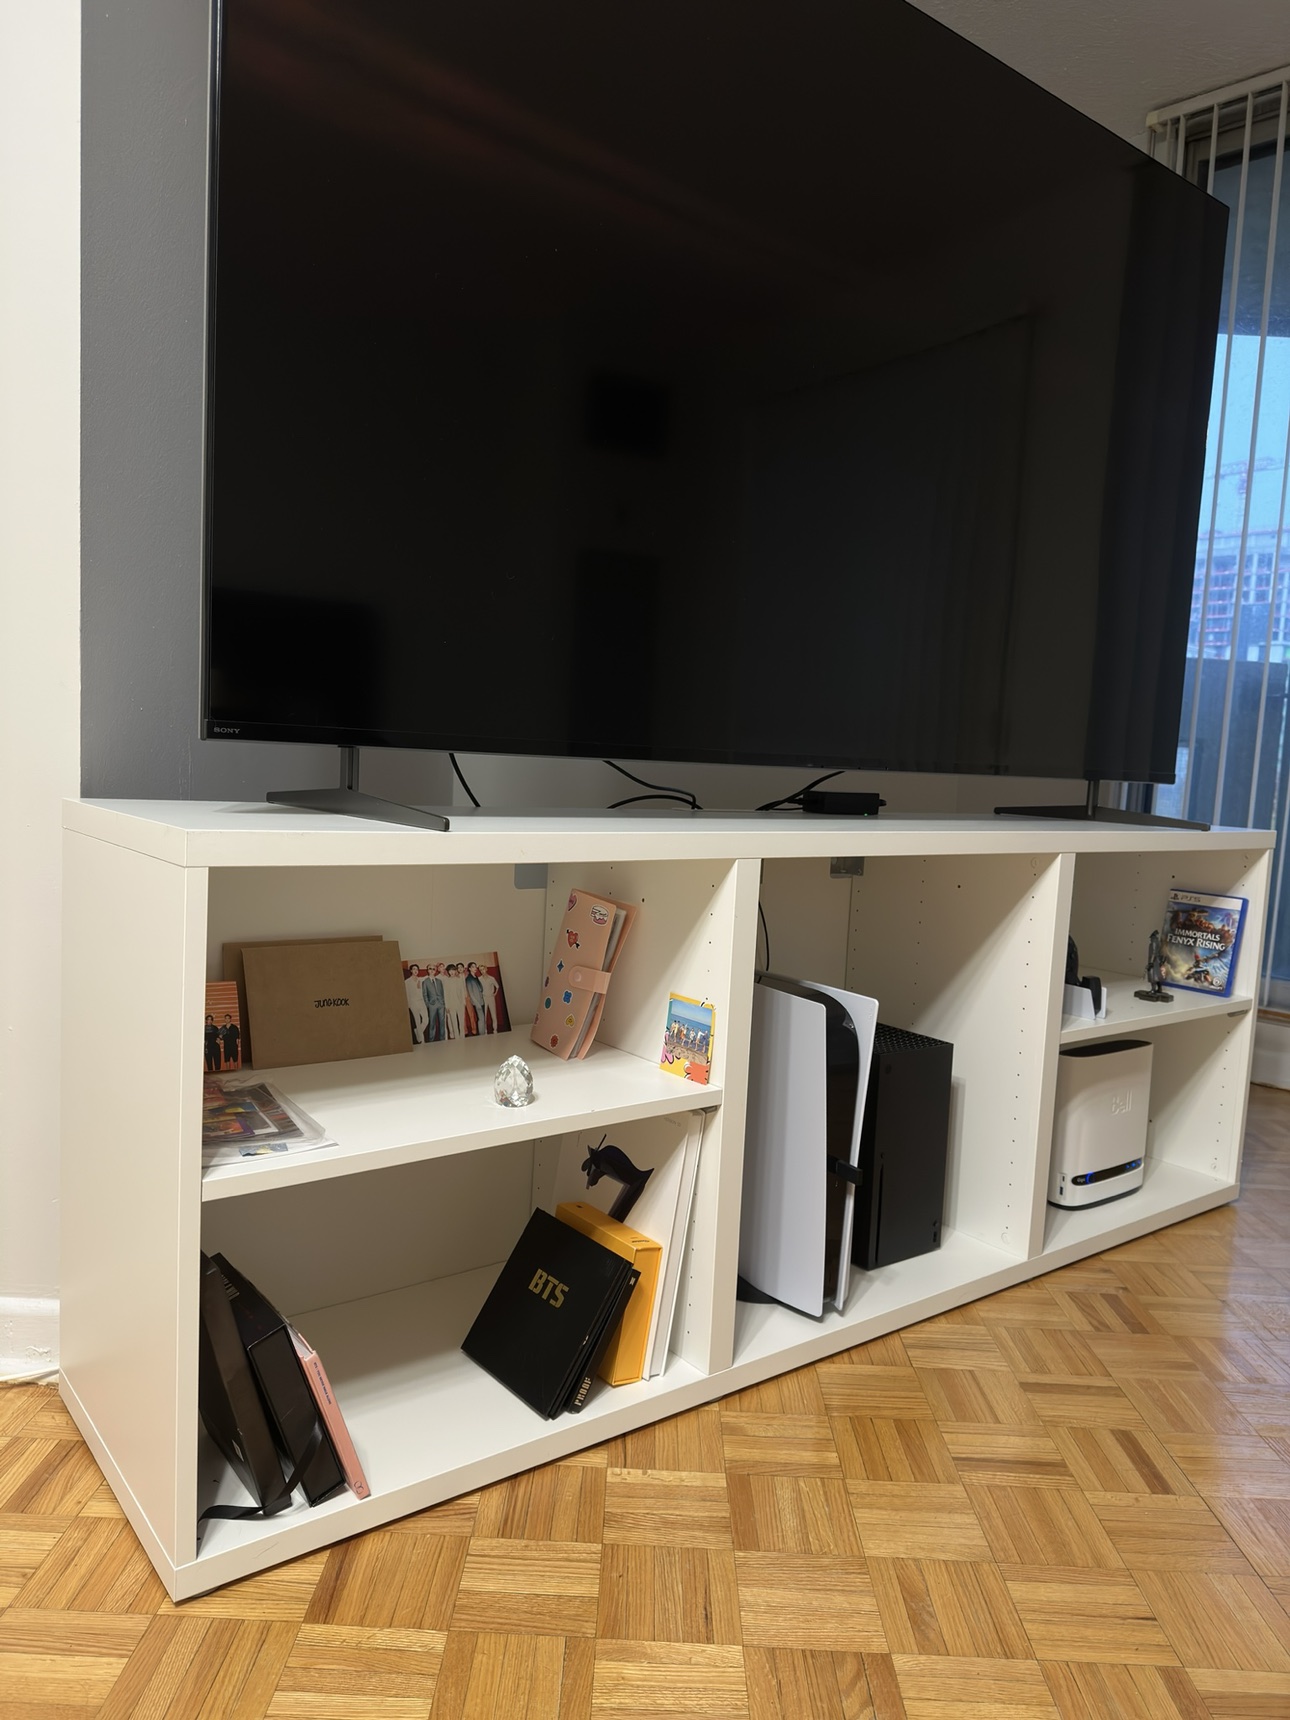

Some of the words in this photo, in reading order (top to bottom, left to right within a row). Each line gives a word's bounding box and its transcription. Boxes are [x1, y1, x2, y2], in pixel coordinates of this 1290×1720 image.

[1181, 894, 1201, 902] PS5
[1167, 933, 1195, 946] FENYX
[1196, 938, 1226, 951] RISING
[1174, 928, 1220, 941] IMMORTALS
[1111, 1090, 1132, 1115] Bell
[528, 1268, 569, 1308] BTS
